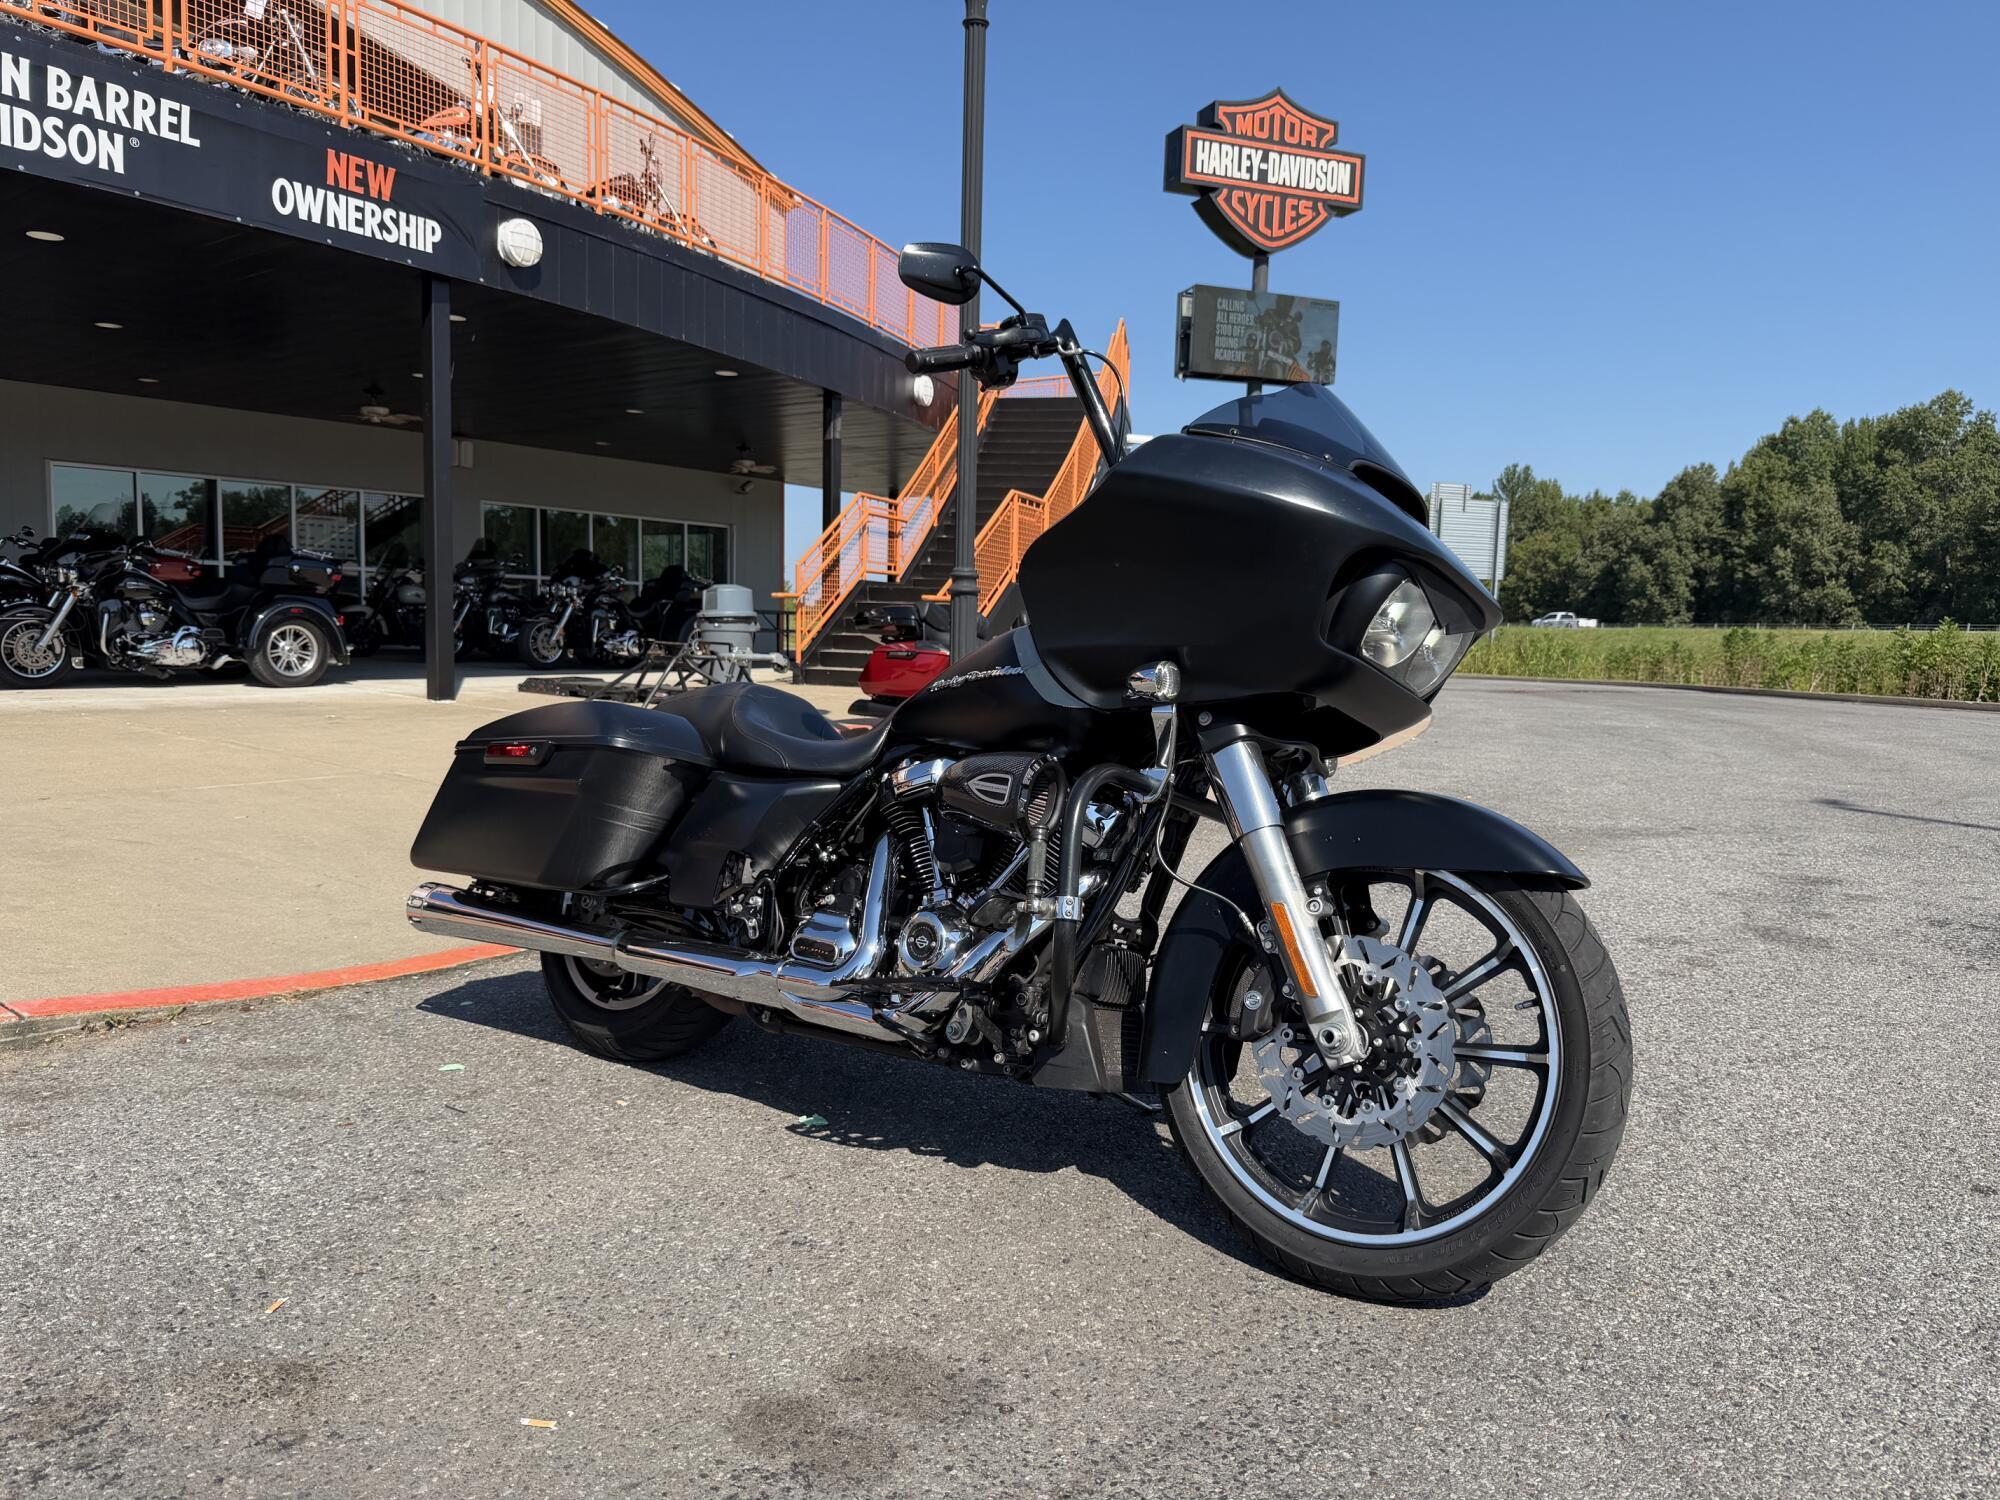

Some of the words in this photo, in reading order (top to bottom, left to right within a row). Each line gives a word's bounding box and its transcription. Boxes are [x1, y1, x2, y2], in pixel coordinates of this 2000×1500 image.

[47, 65, 200, 147] BARREL
[1236, 105, 1317, 147] MOTOR
[327, 149, 397, 202] NEW
[1196, 140, 1351, 195] HARLEY-DAVIDSON
[272, 177, 442, 253] OWNERSHIP
[1232, 190, 1314, 237] CYCLES
[1216, 311, 1228, 323] ALL
[1217, 298, 1245, 312] CALLING
[1233, 325, 1245, 337] OFF
